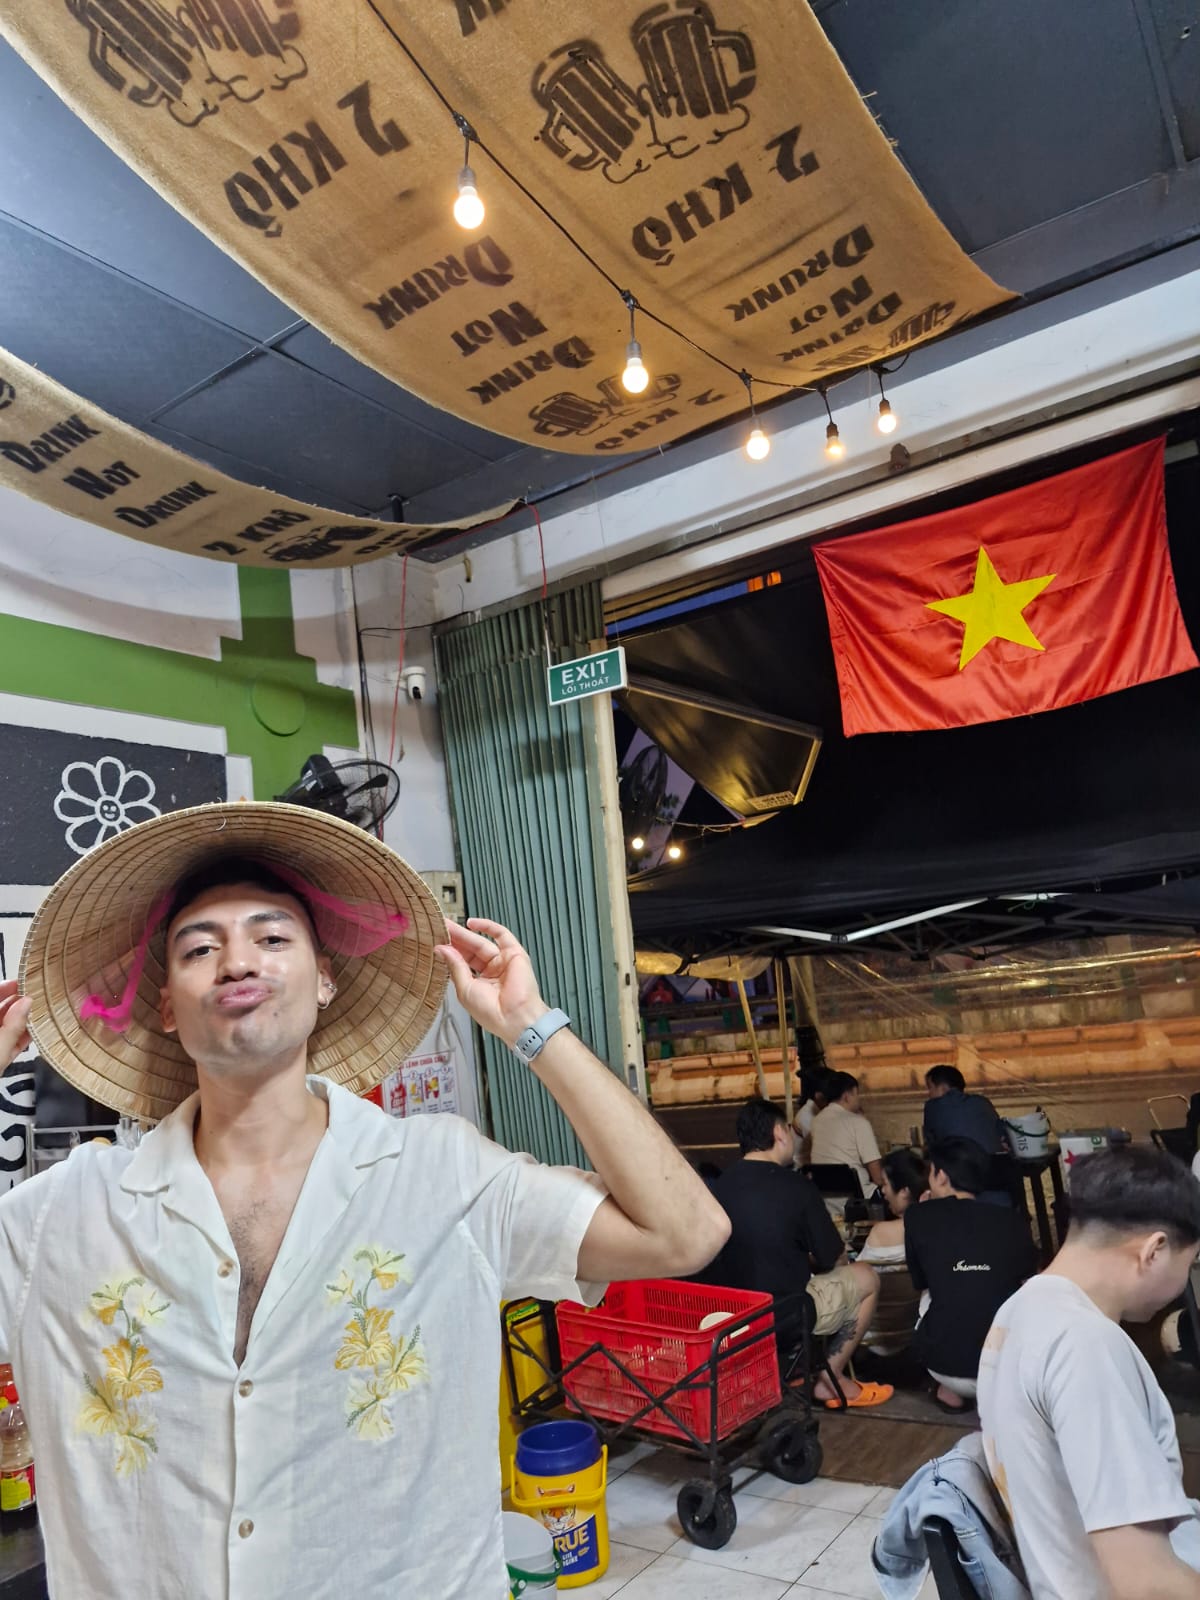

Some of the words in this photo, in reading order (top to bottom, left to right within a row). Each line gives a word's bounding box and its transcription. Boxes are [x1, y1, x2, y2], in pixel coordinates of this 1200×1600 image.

[338, 81, 411, 156] 2
[764, 124, 820, 183] 2
[724, 224, 875, 322] DRUNK
[562, 658, 608, 685] EXIT
[554, 1524, 589, 1552] RUE
